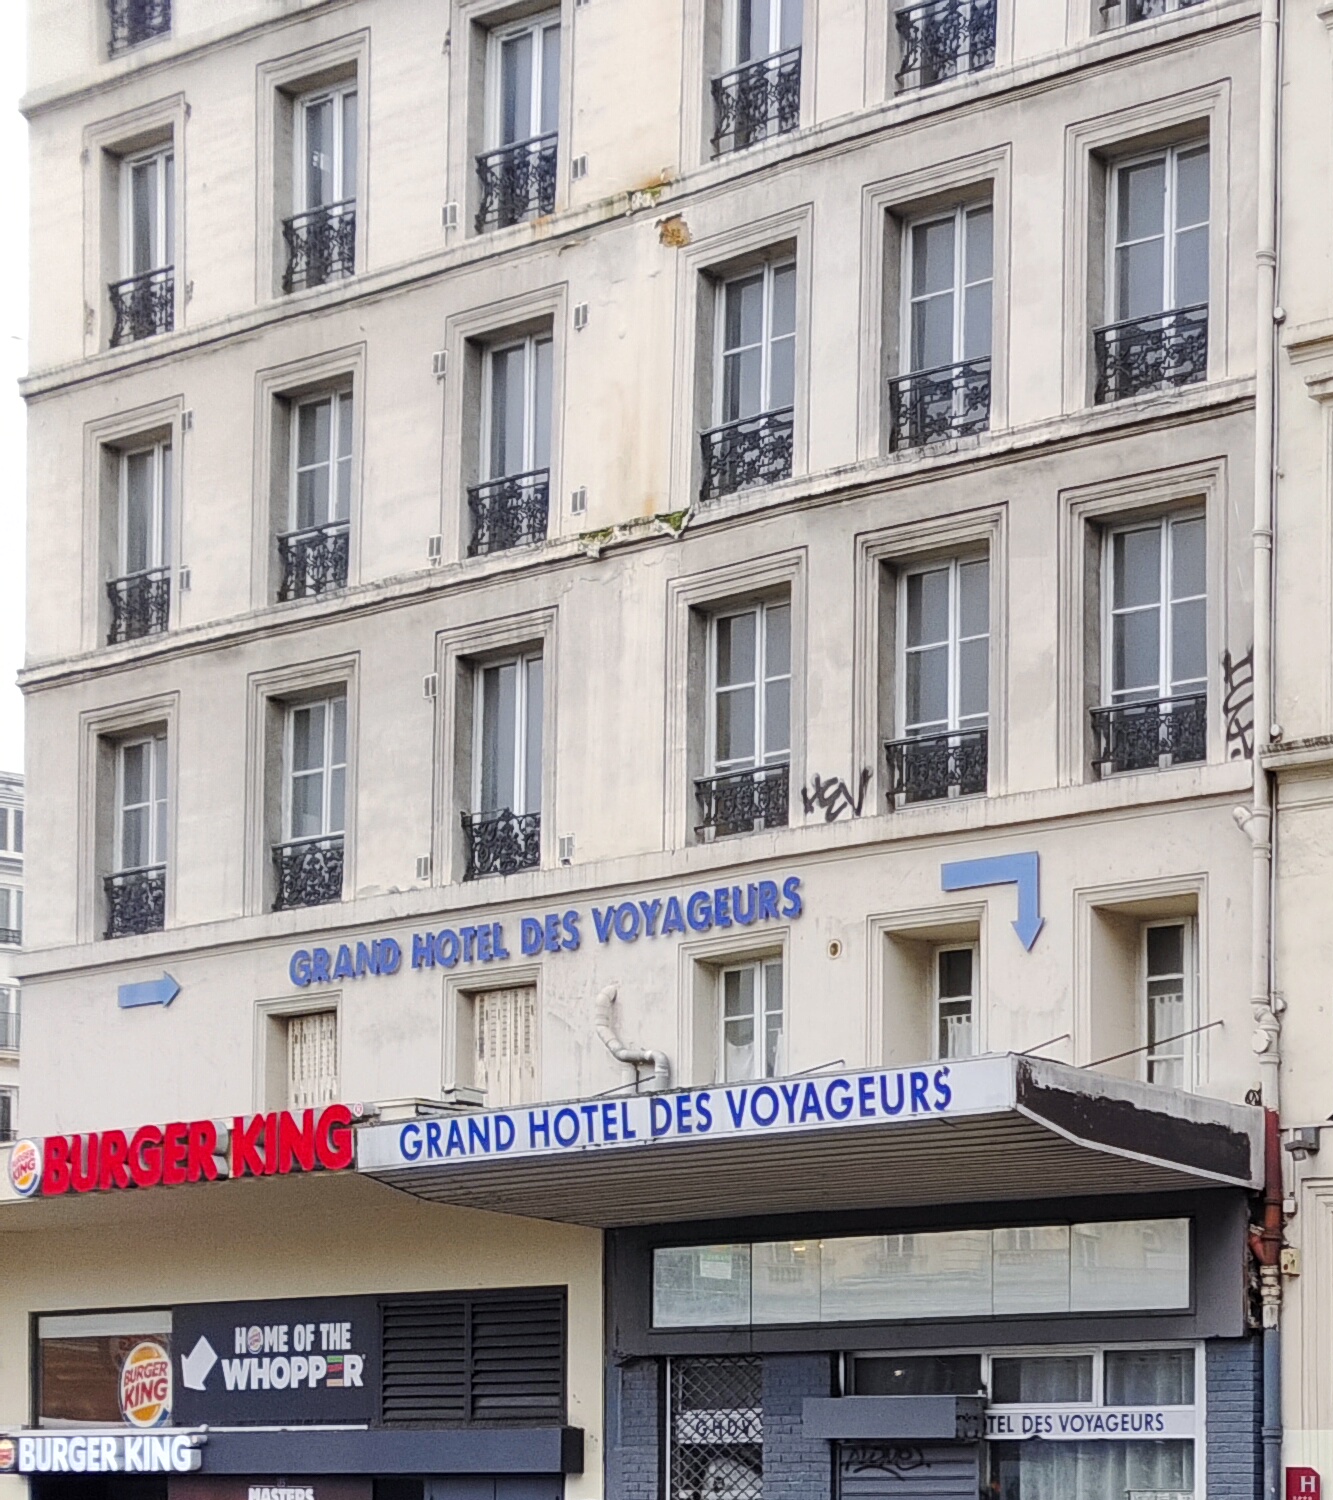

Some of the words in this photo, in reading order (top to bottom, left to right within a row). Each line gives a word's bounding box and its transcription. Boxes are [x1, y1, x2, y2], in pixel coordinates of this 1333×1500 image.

[289, 937, 400, 988] GRAND
[411, 922, 508, 969] HOTEL
[520, 911, 580, 957] DES
[592, 876, 802, 943] VOYAGEURS
[398, 1112, 516, 1162] GRAND
[529, 1100, 638, 1154] HOTEL
[651, 1091, 714, 1136] DES
[726, 1068, 953, 1130] VOYAGEURS
[41, 1119, 218, 1197] BURGER
[230, 1103, 352, 1178] KING
[13, 1158, 36, 1180] KING
[234, 1325, 288, 1354] HOME
[293, 1324, 315, 1351] OF
[320, 1322, 351, 1350] THE
[123, 1361, 168, 1387] BURGER
[123, 1379, 168, 1411] KING
[1022, 1414, 1052, 1433] DES
[1059, 1413, 1164, 1432] VOYAGEURS
[18, 1436, 119, 1472] BURGER
[124, 1435, 192, 1472] KING
[1300, 1475, 1316, 1493] H
